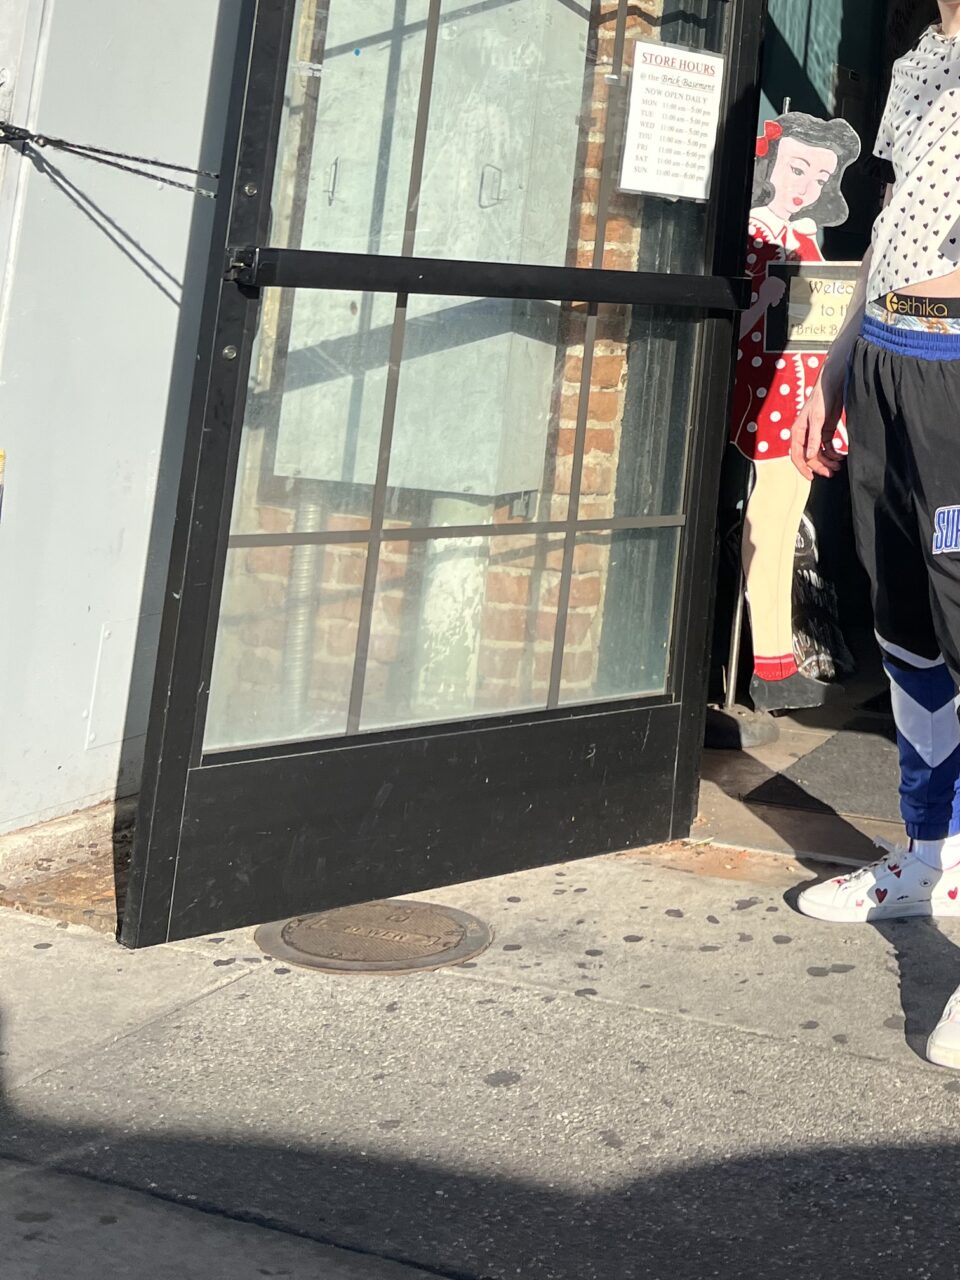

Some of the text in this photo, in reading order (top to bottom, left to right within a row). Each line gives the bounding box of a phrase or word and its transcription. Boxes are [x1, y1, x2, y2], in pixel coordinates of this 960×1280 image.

[642, 53, 715, 77] STORE HOURS
[665, 91, 683, 100] OPEN
[820, 304, 835, 317] to
[897, 297, 948, 318] ethika
